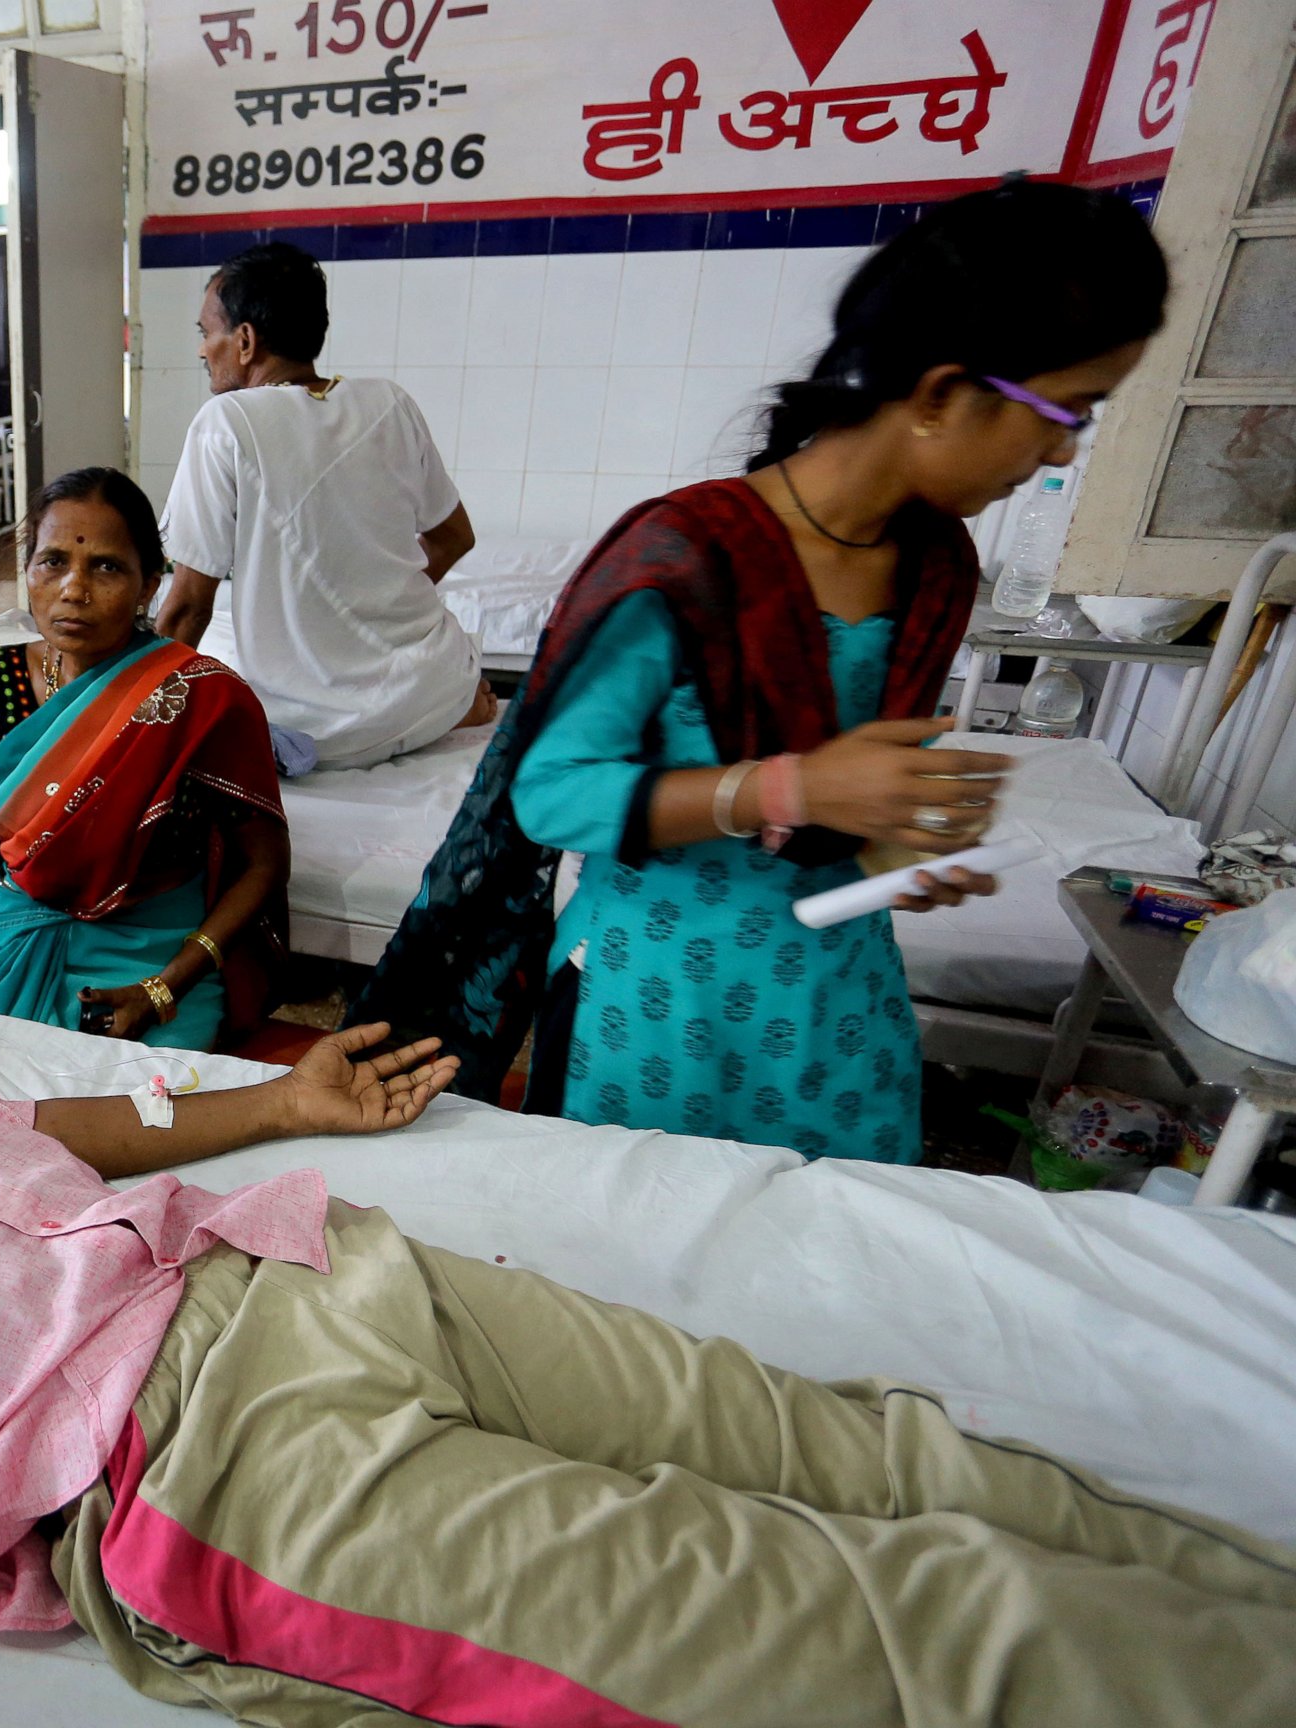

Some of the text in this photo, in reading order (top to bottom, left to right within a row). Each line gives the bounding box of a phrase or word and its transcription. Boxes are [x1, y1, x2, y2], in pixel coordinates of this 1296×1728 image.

[294, 0, 489, 62] 150/-
[582, 57, 701, 182] ही
[172, 133, 486, 198] 8889012386
